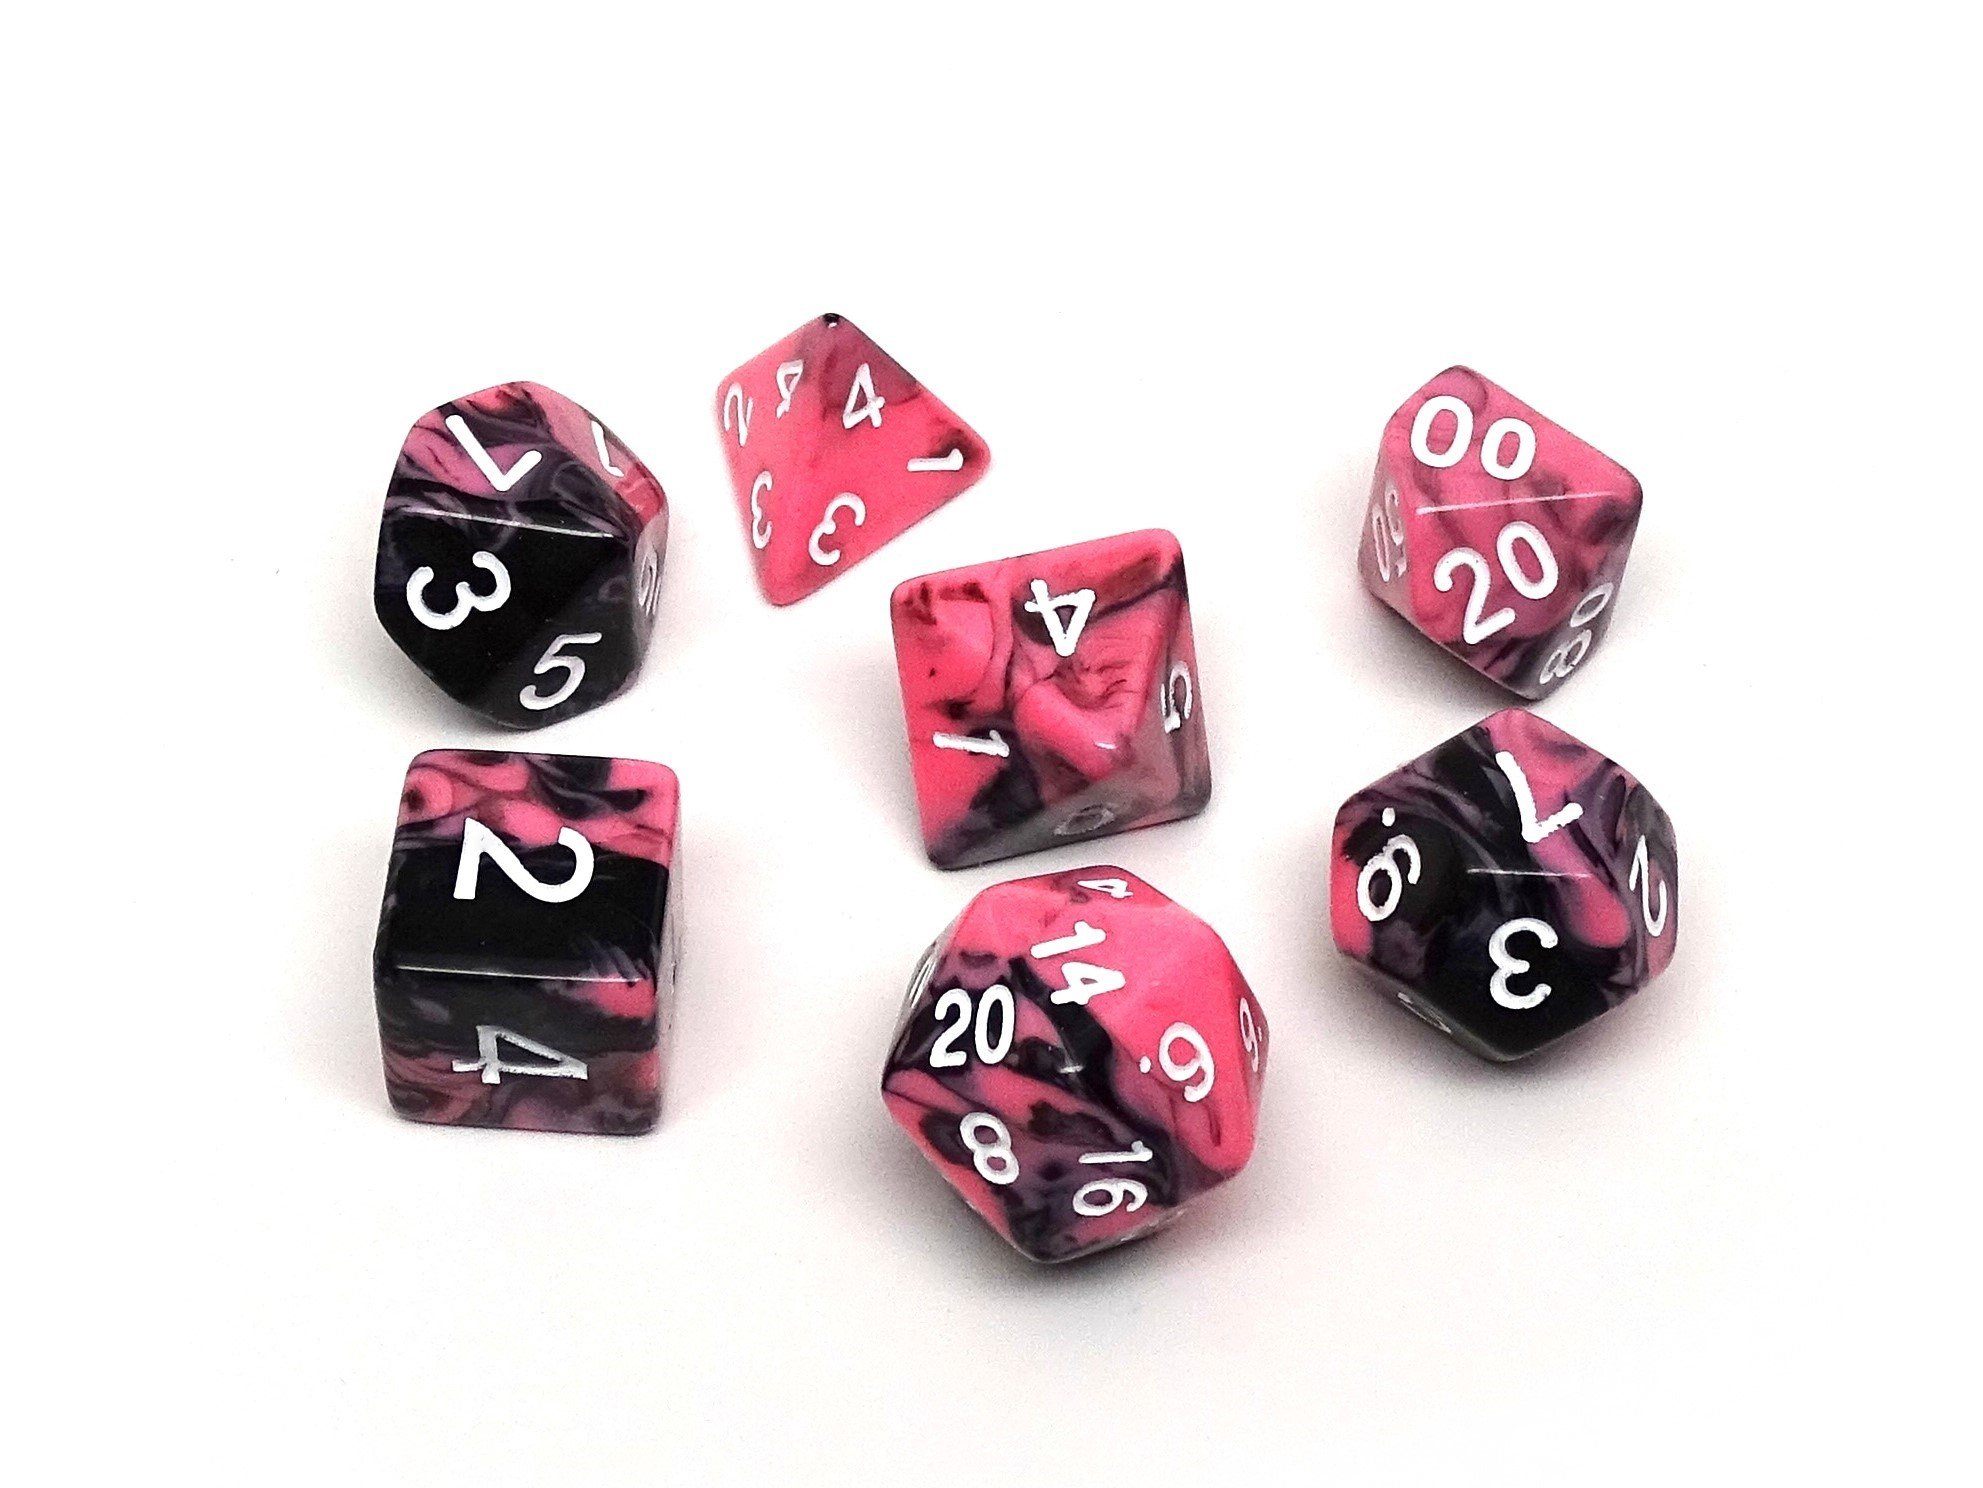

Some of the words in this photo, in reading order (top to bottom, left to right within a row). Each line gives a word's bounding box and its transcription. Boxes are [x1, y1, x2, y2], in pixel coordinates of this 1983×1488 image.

[723, 382, 753, 447] 2
[776, 358, 803, 419] 4
[843, 363, 885, 429] 4
[445, 414, 542, 492] 7
[907, 449, 963, 471] 1
[1410, 396, 1536, 481] 00
[751, 469, 772, 549] 3
[809, 492, 866, 565] 3
[406, 551, 511, 630] 3
[1024, 579, 1095, 656] 4
[1434, 521, 1559, 645] 20
[519, 632, 602, 710] 5
[1539, 582, 1614, 684] 80
[933, 729, 1010, 758] 1
[1495, 751, 1584, 843] 7
[453, 817, 595, 903] 2
[1078, 878, 1133, 899] 4
[1629, 835, 1667, 937] 2
[1030, 921, 1126, 1005] 14
[1489, 917, 1558, 1010] 3
[452, 1025, 588, 1084] 4
[929, 985, 1015, 1068] 20
[959, 1112, 1019, 1184] 8
[1073, 1141, 1153, 1216] 16
